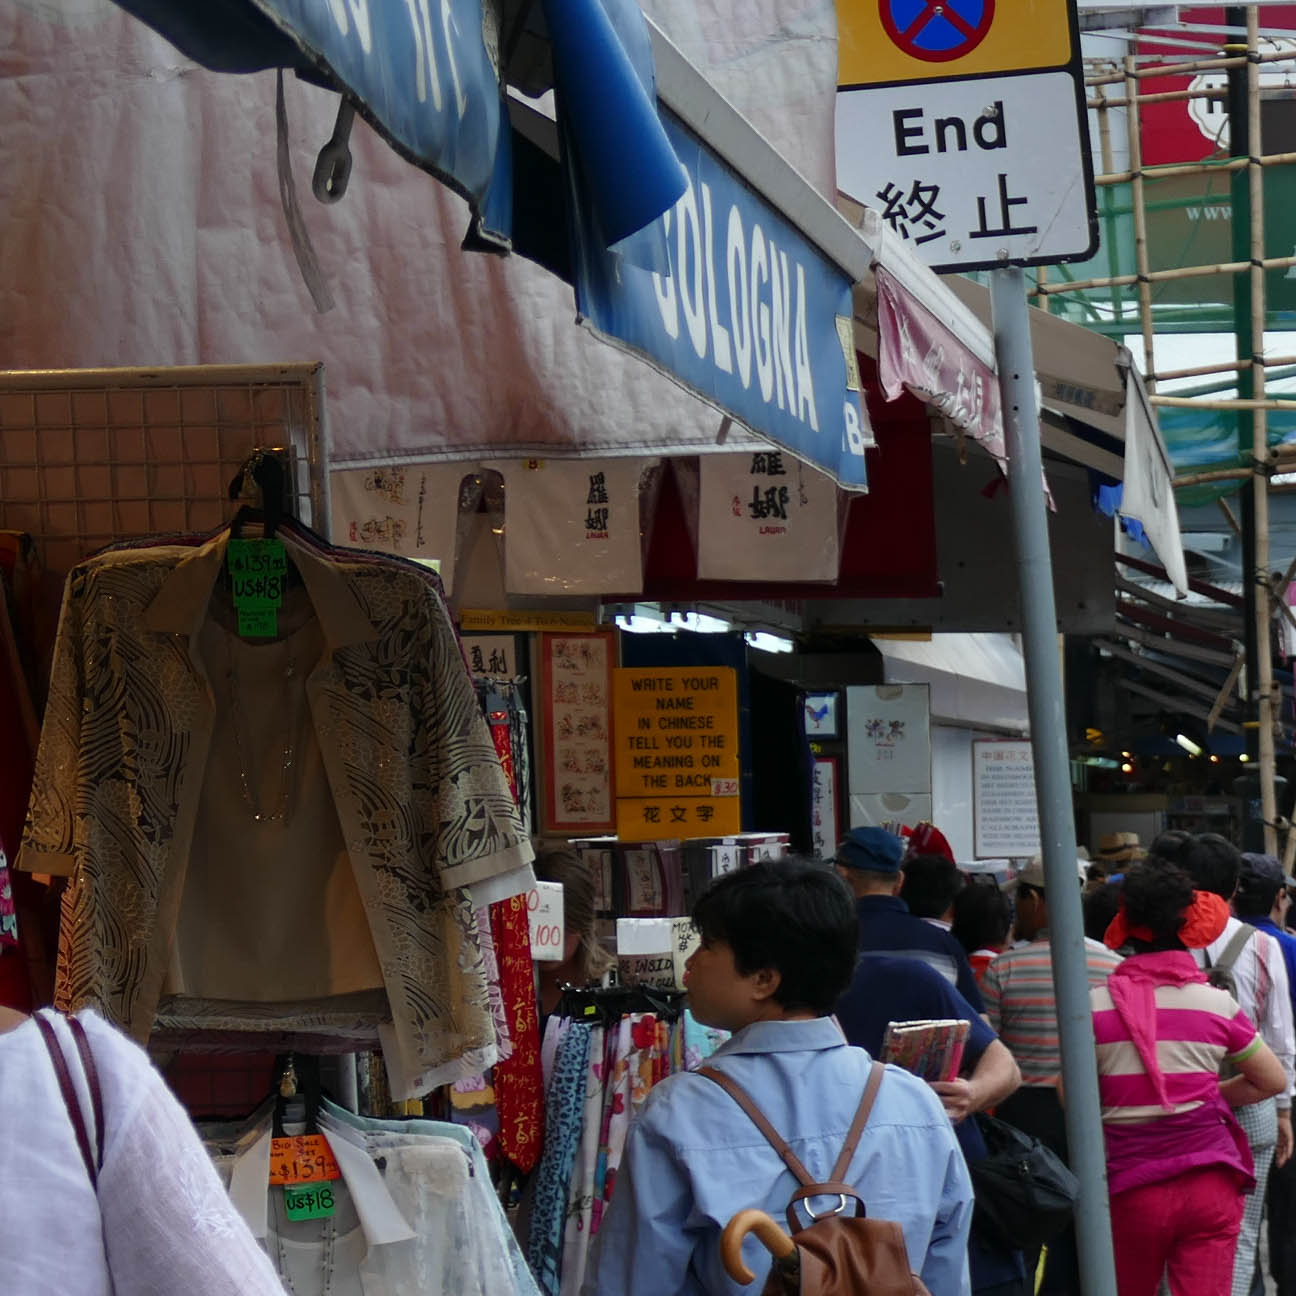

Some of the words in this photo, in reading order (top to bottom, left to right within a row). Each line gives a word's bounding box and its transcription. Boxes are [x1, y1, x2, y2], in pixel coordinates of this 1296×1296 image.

[892, 101, 1007, 156] End
[875, 173, 1038, 245] 終止
[631, 678, 673, 691] WRITE
[682, 677, 719, 691] YOUR
[656, 697, 694, 711] NAME
[638, 717, 650, 730] IN
[658, 716, 715, 730] CHINESE
[628, 736, 660, 750] TELL
[666, 736, 693, 749] YOU
[700, 735, 725, 748] THE
[633, 756, 694, 769] MEANING
[702, 755, 720, 768] ON
[641, 775, 668, 788] THE
[675, 775, 712, 788] BACK
[642, 805, 714, 823] 花文字
[286, 1188, 335, 1213] US$18
